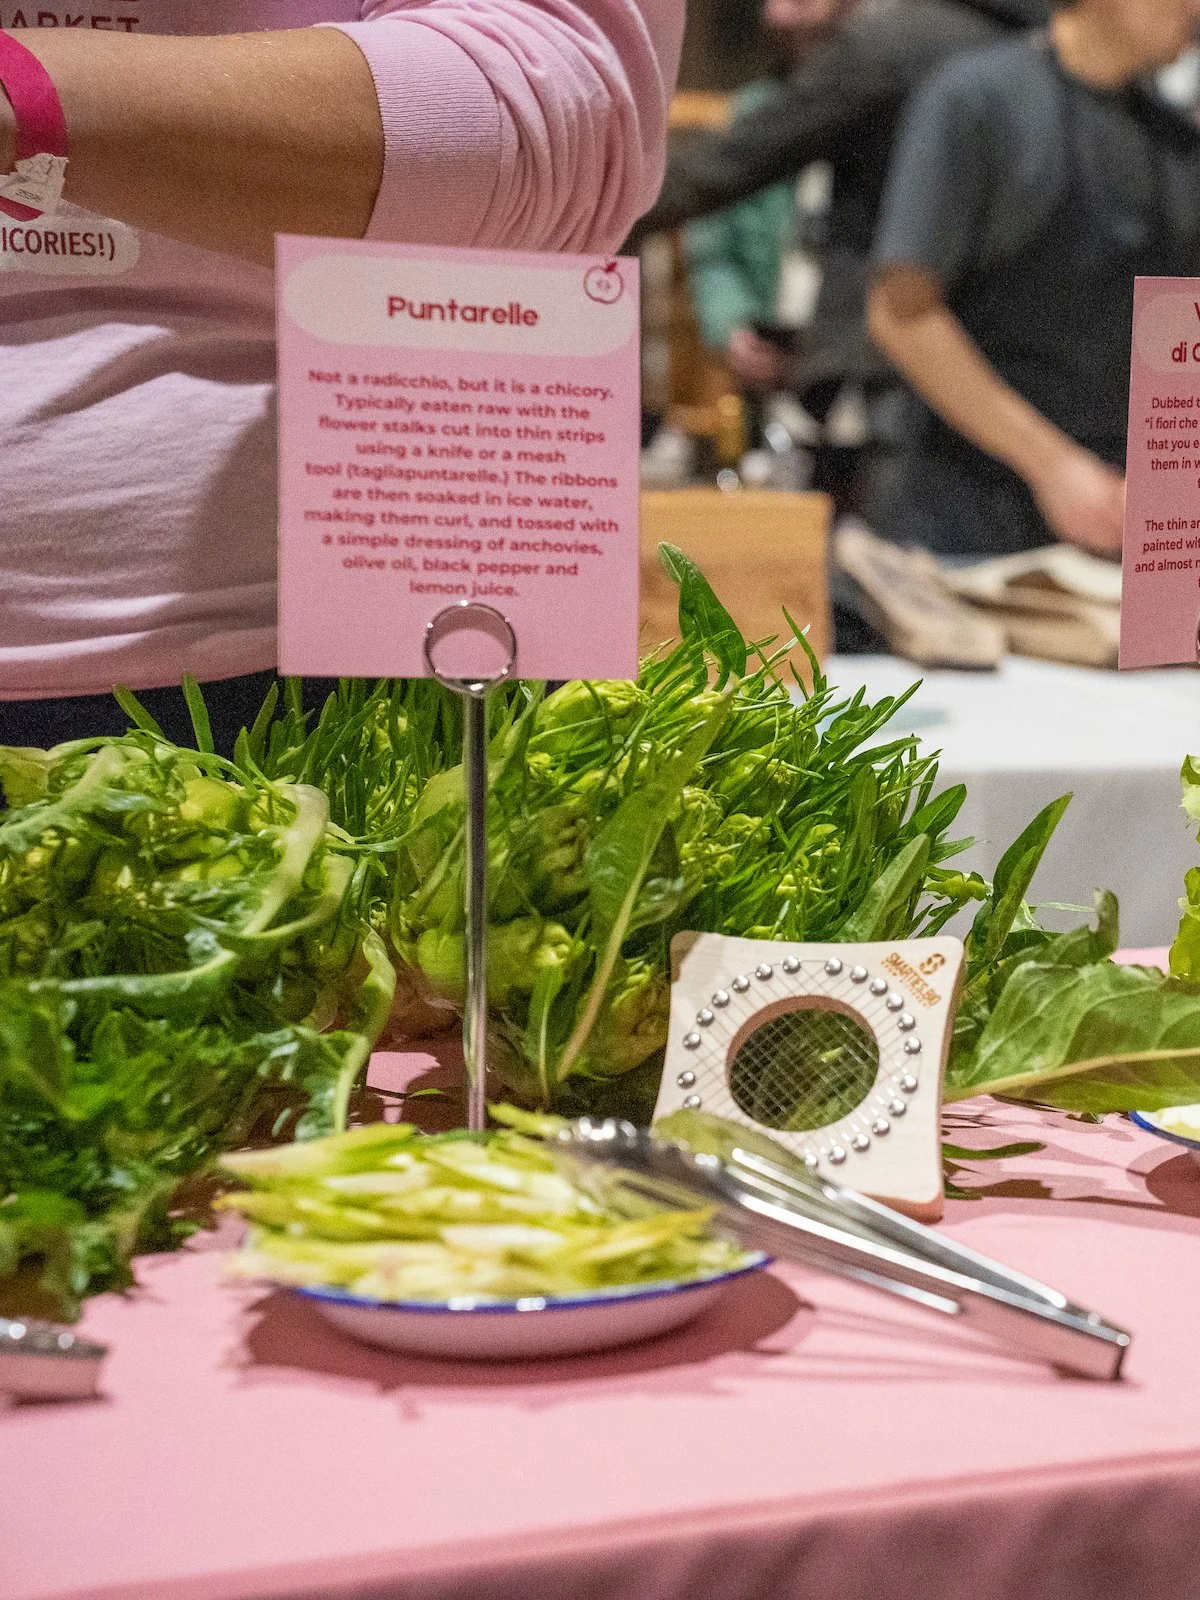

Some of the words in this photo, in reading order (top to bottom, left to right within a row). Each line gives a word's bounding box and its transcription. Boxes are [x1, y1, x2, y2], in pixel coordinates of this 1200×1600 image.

[387, 296, 539, 325] Puntarelle
[1171, 341, 1187, 362] di
[308, 369, 342, 384] Not
[347, 373, 359, 385] a
[458, 377, 488, 392] but
[493, 378, 506, 393] it
[510, 379, 526, 394] is
[529, 383, 541, 395] a
[334, 393, 416, 413] Typically
[420, 400, 472, 413] eaten
[477, 403, 512, 415] raw
[516, 404, 556, 417] with
[560, 405, 590, 420] the
[1151, 396, 1194, 409] Dubbed
[318, 414, 378, 431] flower
[382, 420, 436, 435] stalks
[440, 423, 470, 436] cut
[476, 424, 512, 438] into
[515, 426, 552, 439] thin
[556, 428, 606, 444] strips
[1155, 416, 1176, 429] fiori
[1178, 416, 1198, 429] che
[355, 442, 407, 459] using
[411, 445, 423, 457] a
[427, 444, 473, 459] knife
[478, 448, 496, 460] or
[501, 449, 512, 461] a
[516, 450, 566, 463] mesh
[1146, 438, 1168, 450] that
[1170, 439, 1190, 452] you
[1150, 458, 1179, 470] them
[1181, 456, 1192, 468] in
[304, 462, 342, 476] tool
[514, 470, 547, 485] The
[551, 472, 618, 488] ribbons
[332, 488, 362, 500] are
[366, 487, 410, 501] then
[414, 491, 480, 504] soaked
[484, 491, 502, 505] in
[506, 492, 533, 507] ice
[303, 508, 376, 526] making
[380, 511, 429, 524] them
[478, 515, 512, 529] and
[516, 517, 576, 531] tossed
[580, 518, 619, 532] with
[1145, 519, 1164, 531] The
[1166, 517, 1188, 530] thin
[322, 533, 333, 545] a
[337, 532, 399, 548] simple
[404, 535, 482, 553] dressing
[486, 537, 505, 551] of
[1142, 538, 1183, 554] painted
[342, 555, 386, 569] olive
[422, 558, 471, 572] black
[476, 562, 540, 576] pepper
[545, 562, 579, 576] and
[1134, 559, 1155, 572] and
[1156, 558, 1192, 571] almost
[409, 580, 467, 594] lemon
